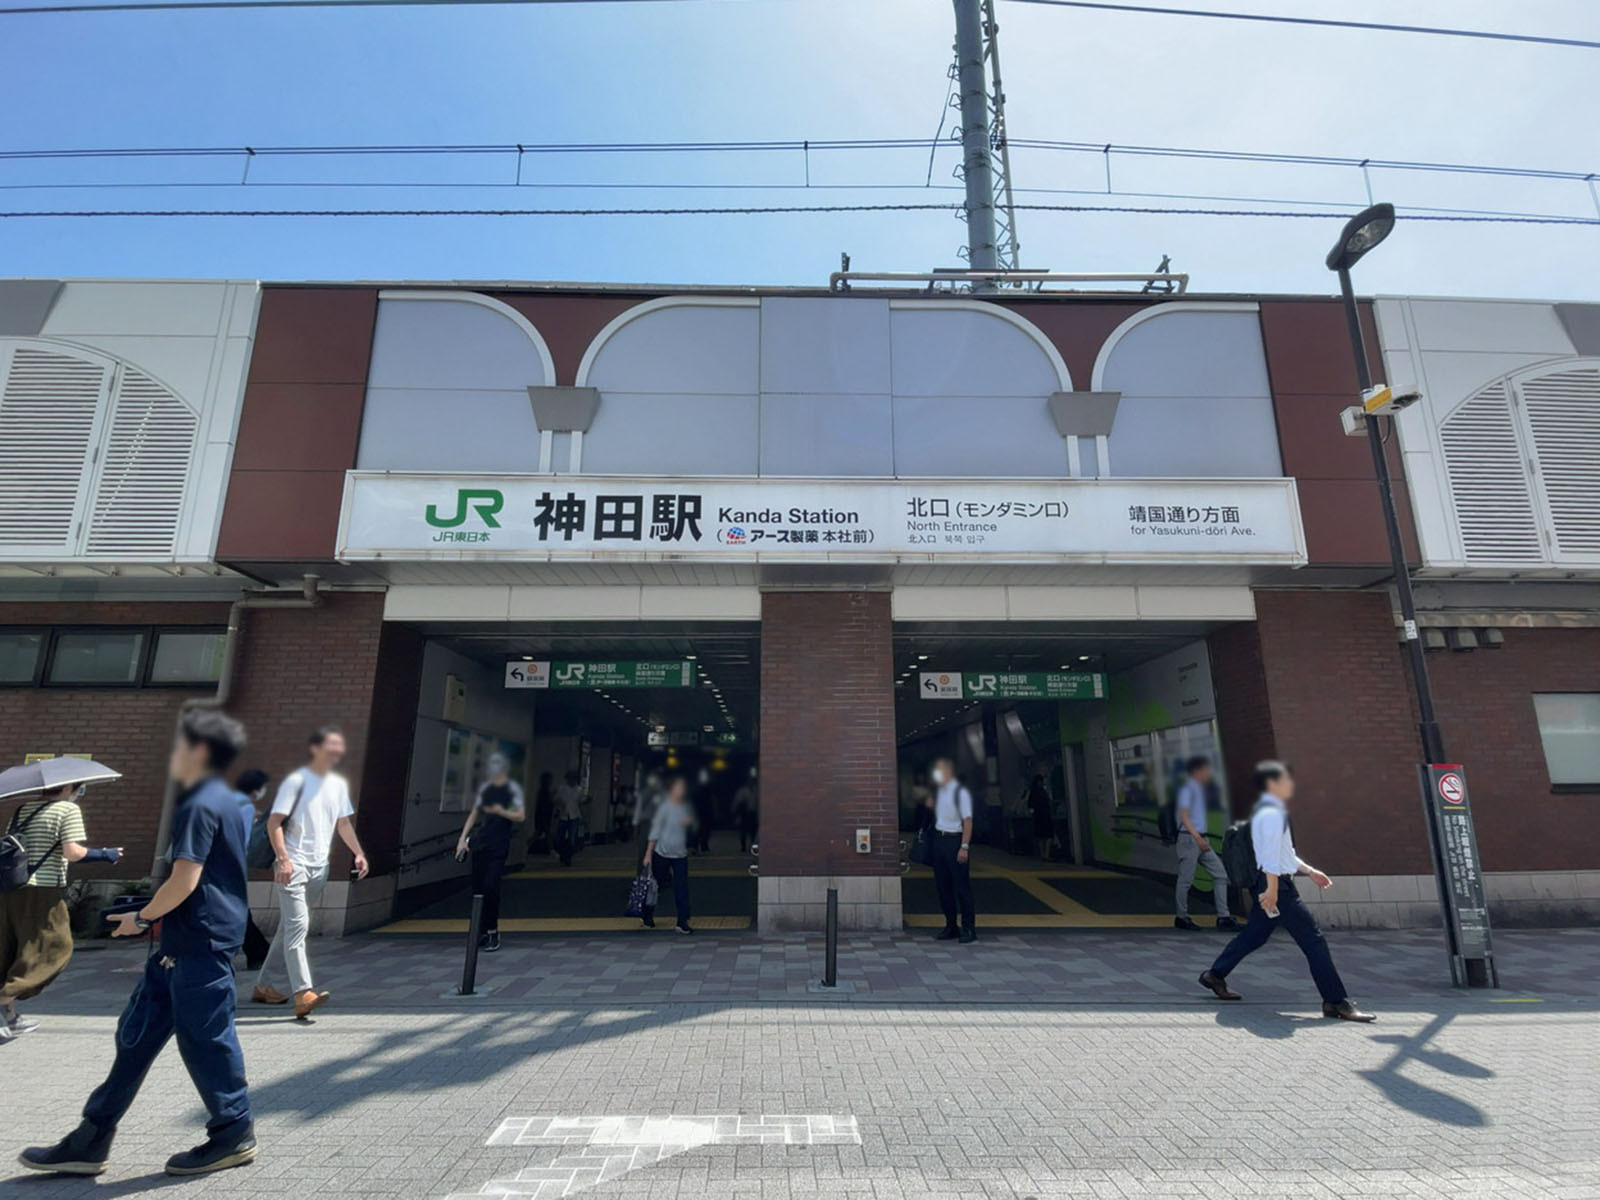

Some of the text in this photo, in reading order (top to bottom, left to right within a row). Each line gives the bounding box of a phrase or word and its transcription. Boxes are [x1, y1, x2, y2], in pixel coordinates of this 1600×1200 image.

[425, 489, 504, 528] JR
[718, 508, 859, 524] Kanda Station
[1129, 505, 1240, 524] 靖国通り方面
[533, 492, 703, 542] 神田駅
[907, 521, 998, 532] North Entrance
[1131, 525, 1146, 536] for
[1231, 526, 1256, 536] Ave.
[433, 531, 491, 543] JR東日本
[908, 534, 937, 544] 北入口
[556, 663, 585, 679] JR
[968, 675, 997, 691] JR
